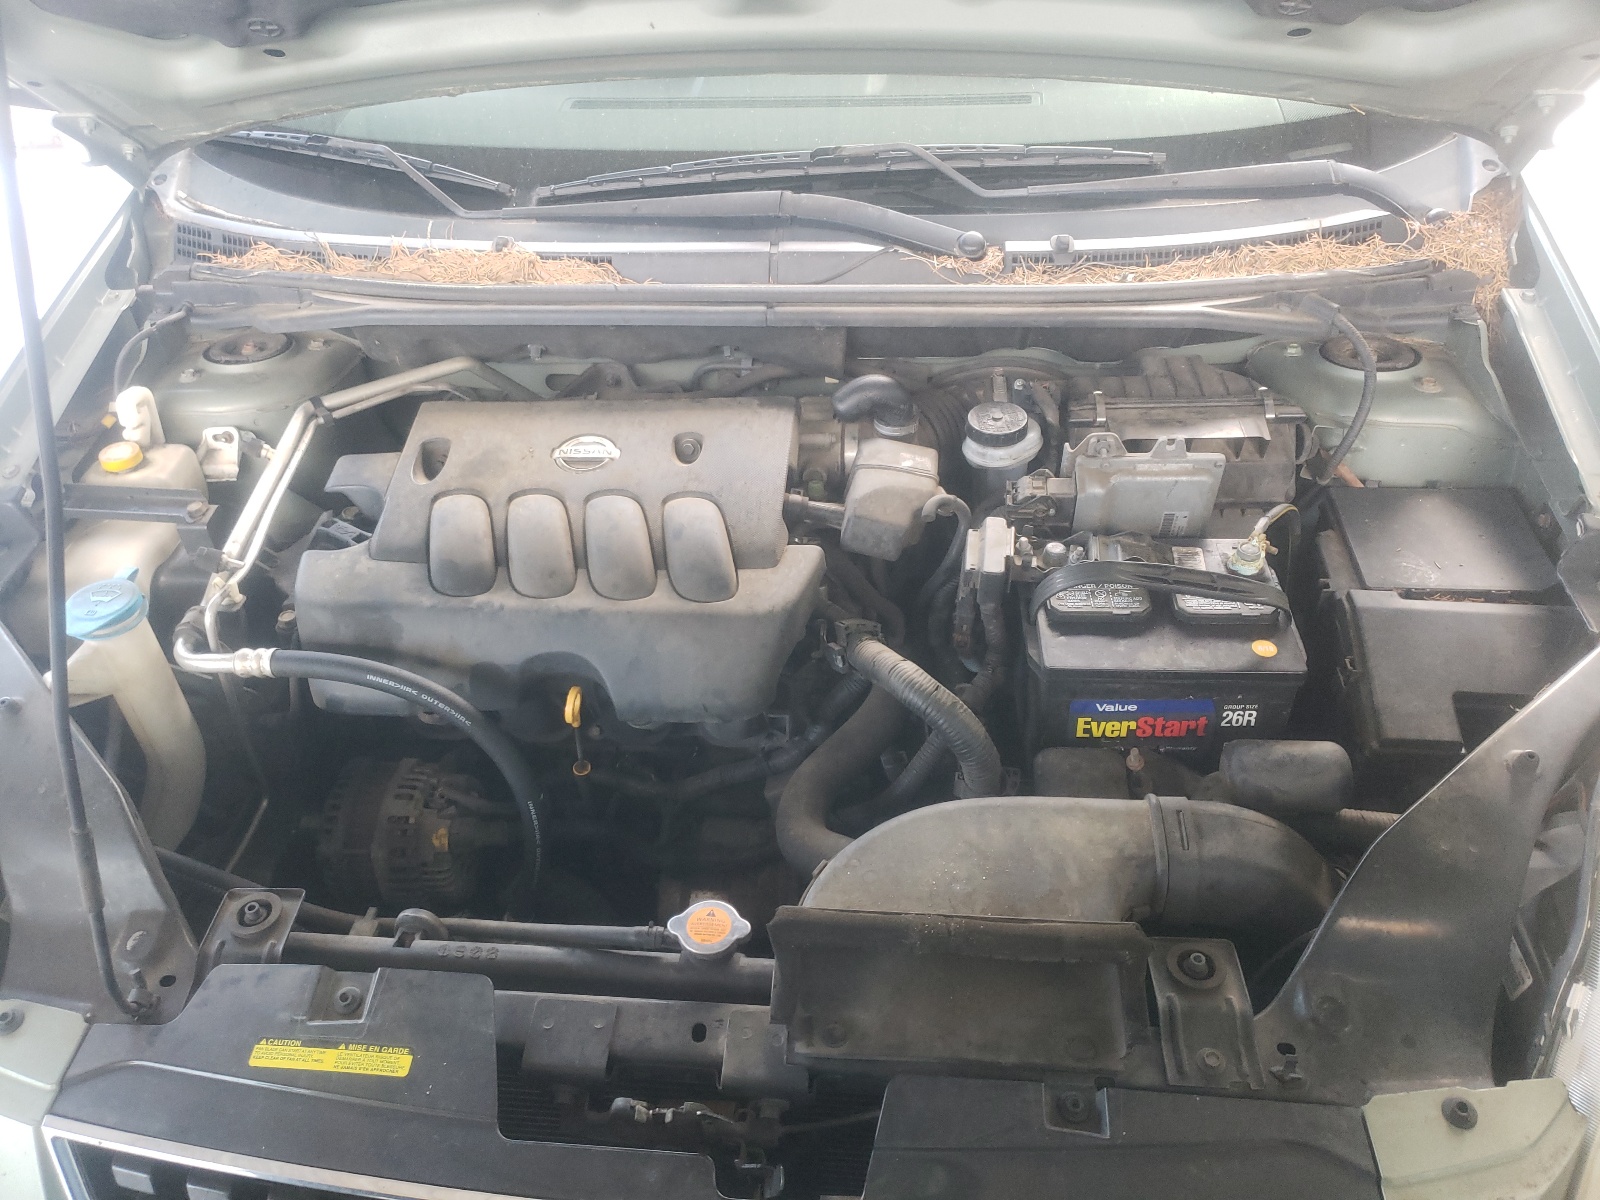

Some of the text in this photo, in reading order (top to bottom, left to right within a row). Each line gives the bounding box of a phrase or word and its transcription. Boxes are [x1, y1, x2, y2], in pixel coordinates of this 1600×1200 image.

[558, 448, 613, 456] NISSAN
[1095, 703, 1138, 712] Value
[1220, 710, 1258, 727] 26R
[1075, 716, 1208, 738] EverStart
[267, 1038, 302, 1046] CAUTION
[348, 1043, 368, 1051] MISE
[381, 1046, 410, 1054] GARDE
